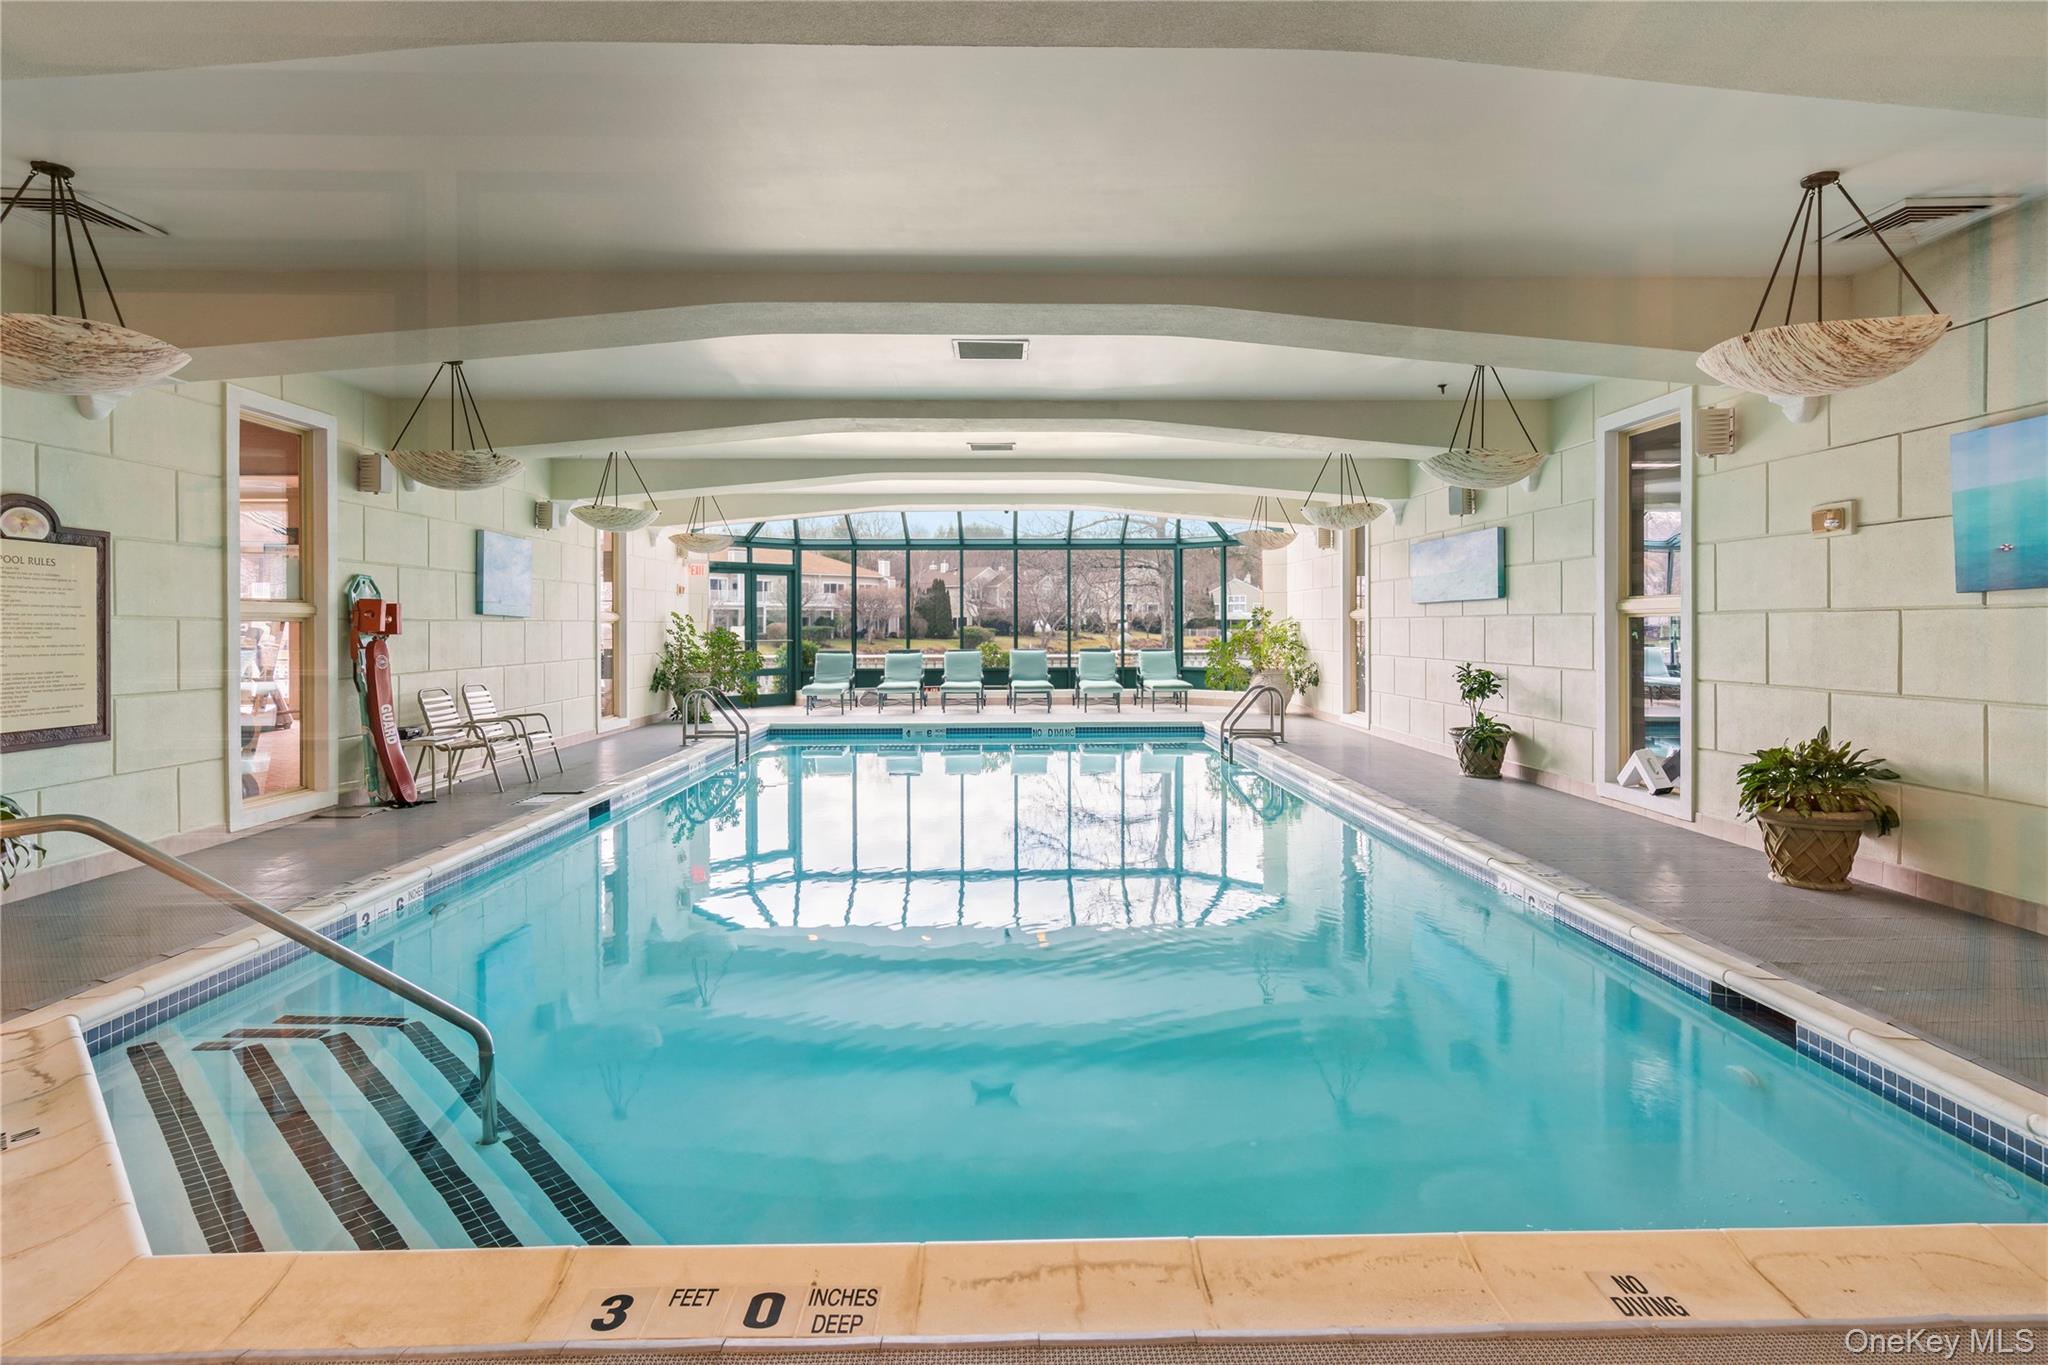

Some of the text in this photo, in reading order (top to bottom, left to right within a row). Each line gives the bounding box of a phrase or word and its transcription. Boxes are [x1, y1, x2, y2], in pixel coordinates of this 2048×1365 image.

[28, 556, 56, 567] RULES
[381, 703, 399, 745] GUARD
[1032, 728, 1043, 737] NO
[1610, 1274, 1649, 1295] NO
[590, 1288, 879, 1332] 3 FEET 0 INCHES
[1610, 1296, 1691, 1317] DIVING
[811, 1314, 864, 1334] DEEP
